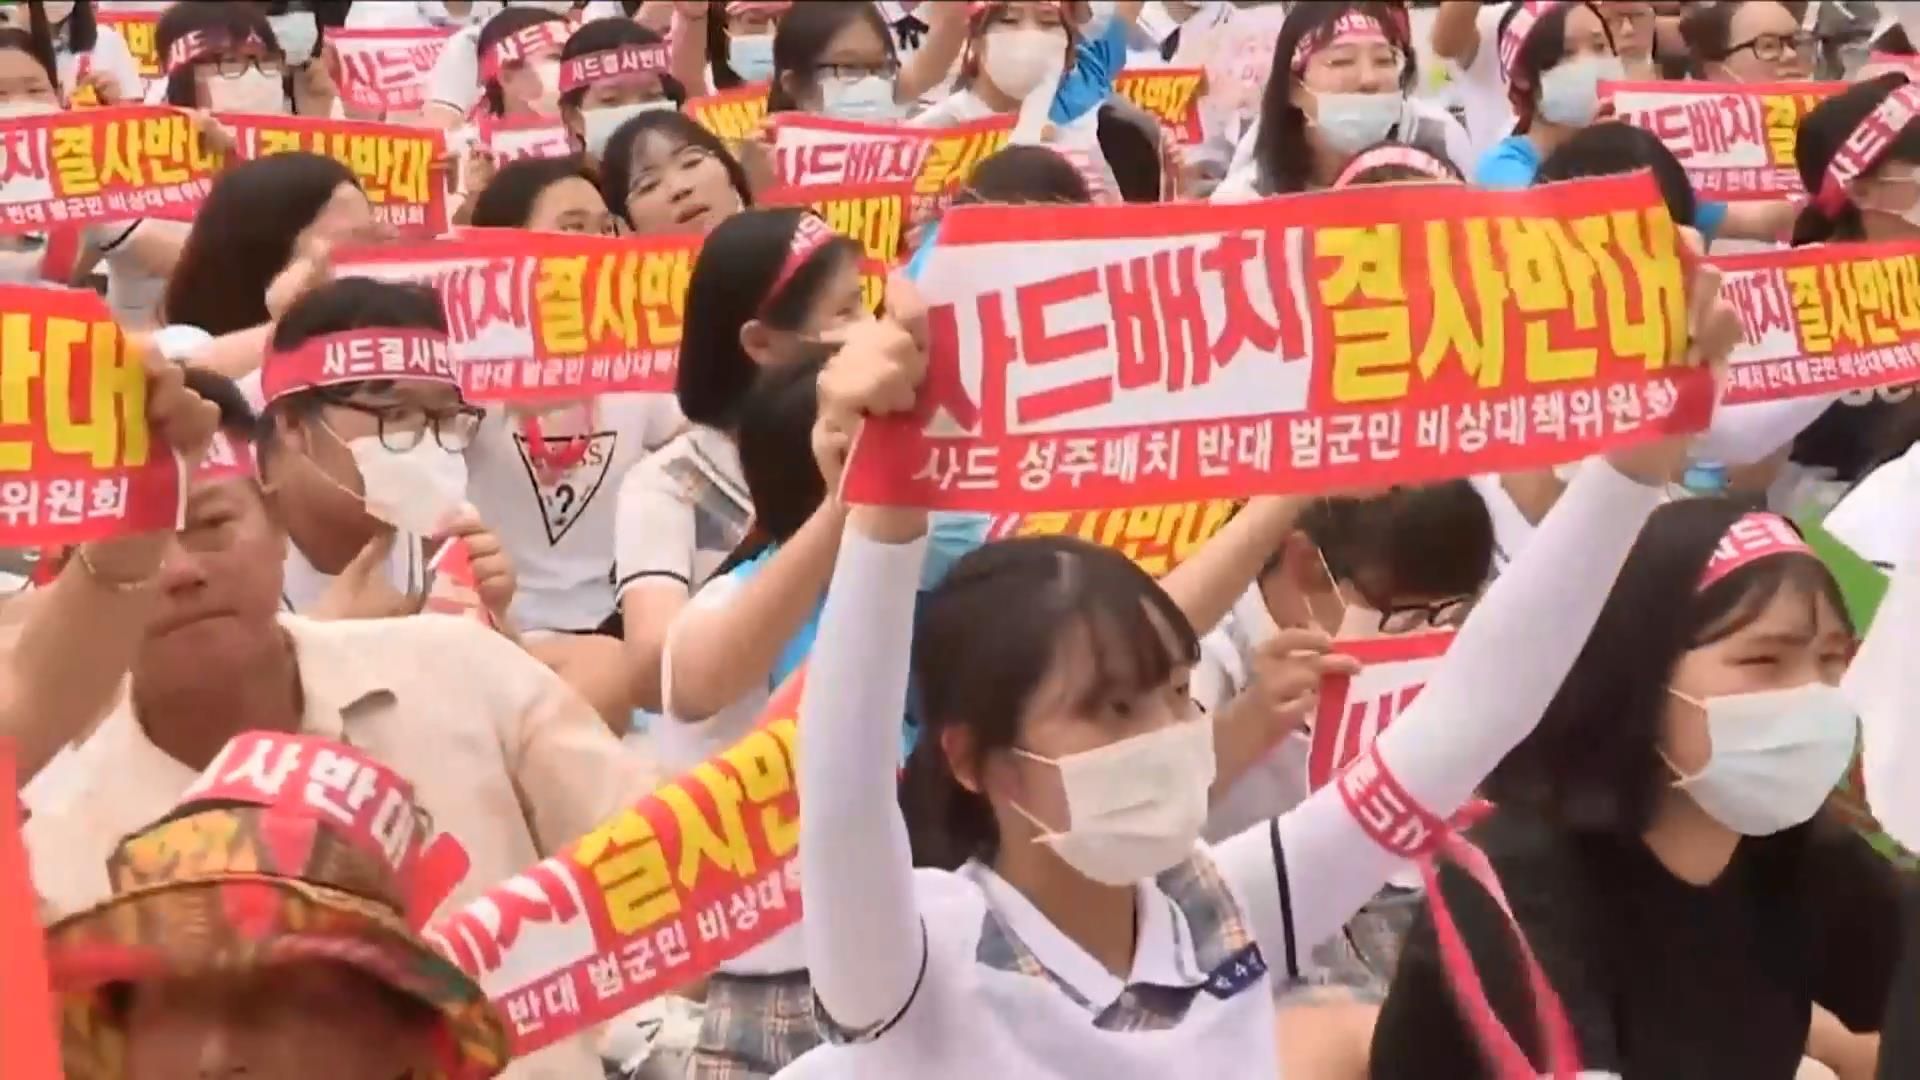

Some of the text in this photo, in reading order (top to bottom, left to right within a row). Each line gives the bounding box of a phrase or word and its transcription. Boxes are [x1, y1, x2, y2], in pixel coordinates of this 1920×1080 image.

[1765, 93, 1817, 170] 결
[920, 205, 1690, 438] 사드배치 결사반대
[911, 376, 1678, 491] 사드 성주배치 반대 범군민 비상대책위원회
[0, 475, 129, 526] 위원회
[506, 972, 580, 1037] 반대
[587, 920, 692, 1001] 범군민
